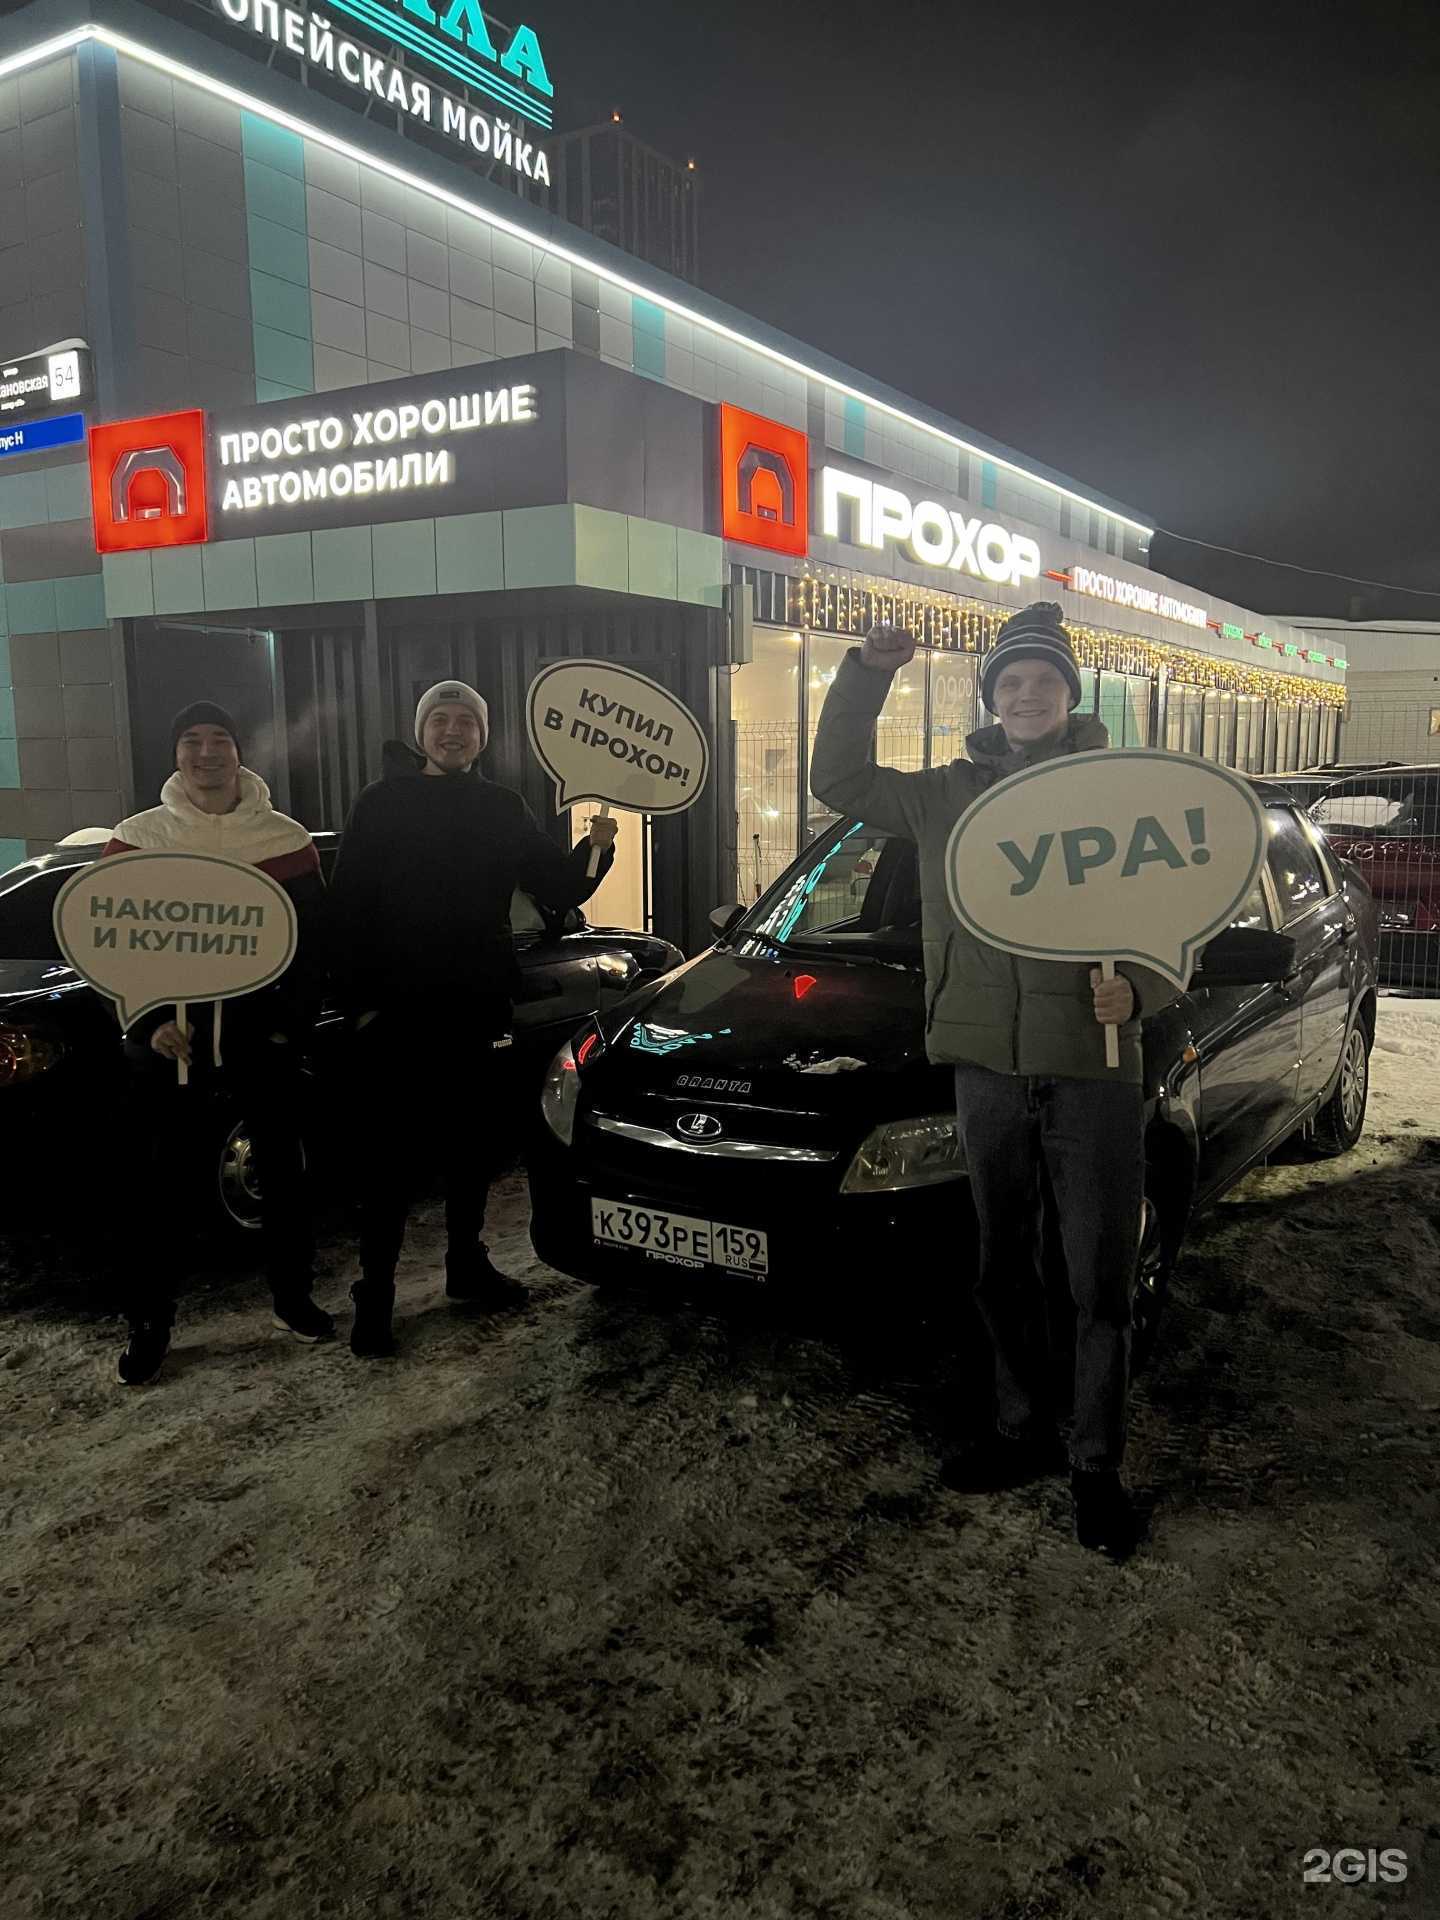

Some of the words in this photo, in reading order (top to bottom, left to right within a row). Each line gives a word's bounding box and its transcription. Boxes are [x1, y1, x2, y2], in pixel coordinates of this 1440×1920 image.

[442, 96, 551, 187] МОЙКА
[0, 375, 48, 398] ановская
[55, 365, 74, 387] 54
[15, 430, 24, 445] Н
[219, 416, 343, 465] ПРОСТО
[351, 384, 536, 446] ХОРОШИЕ
[222, 450, 451, 511] АВТОМОБИЛИ
[822, 465, 1041, 588] ПРОХОР
[1073, 566, 1114, 601] ПРОСТО
[1115, 579, 1159, 614] ХОРОШИЕ
[579, 687, 674, 746] КУПИЛ
[543, 707, 564, 731] В
[569, 718, 691, 787] ПРОХОР!
[996, 807, 1211, 896] УРА!
[90, 896, 265, 928] НАКОПИЛ
[94, 926, 117, 949] И
[128, 928, 259, 956] КУПИЛ!
[676, 1074, 751, 1093] GRANTA
[646, 1250, 704, 1269] ПРОХОР
[715, 1227, 761, 1260] 159
[725, 1254, 748, 1268] RUS
